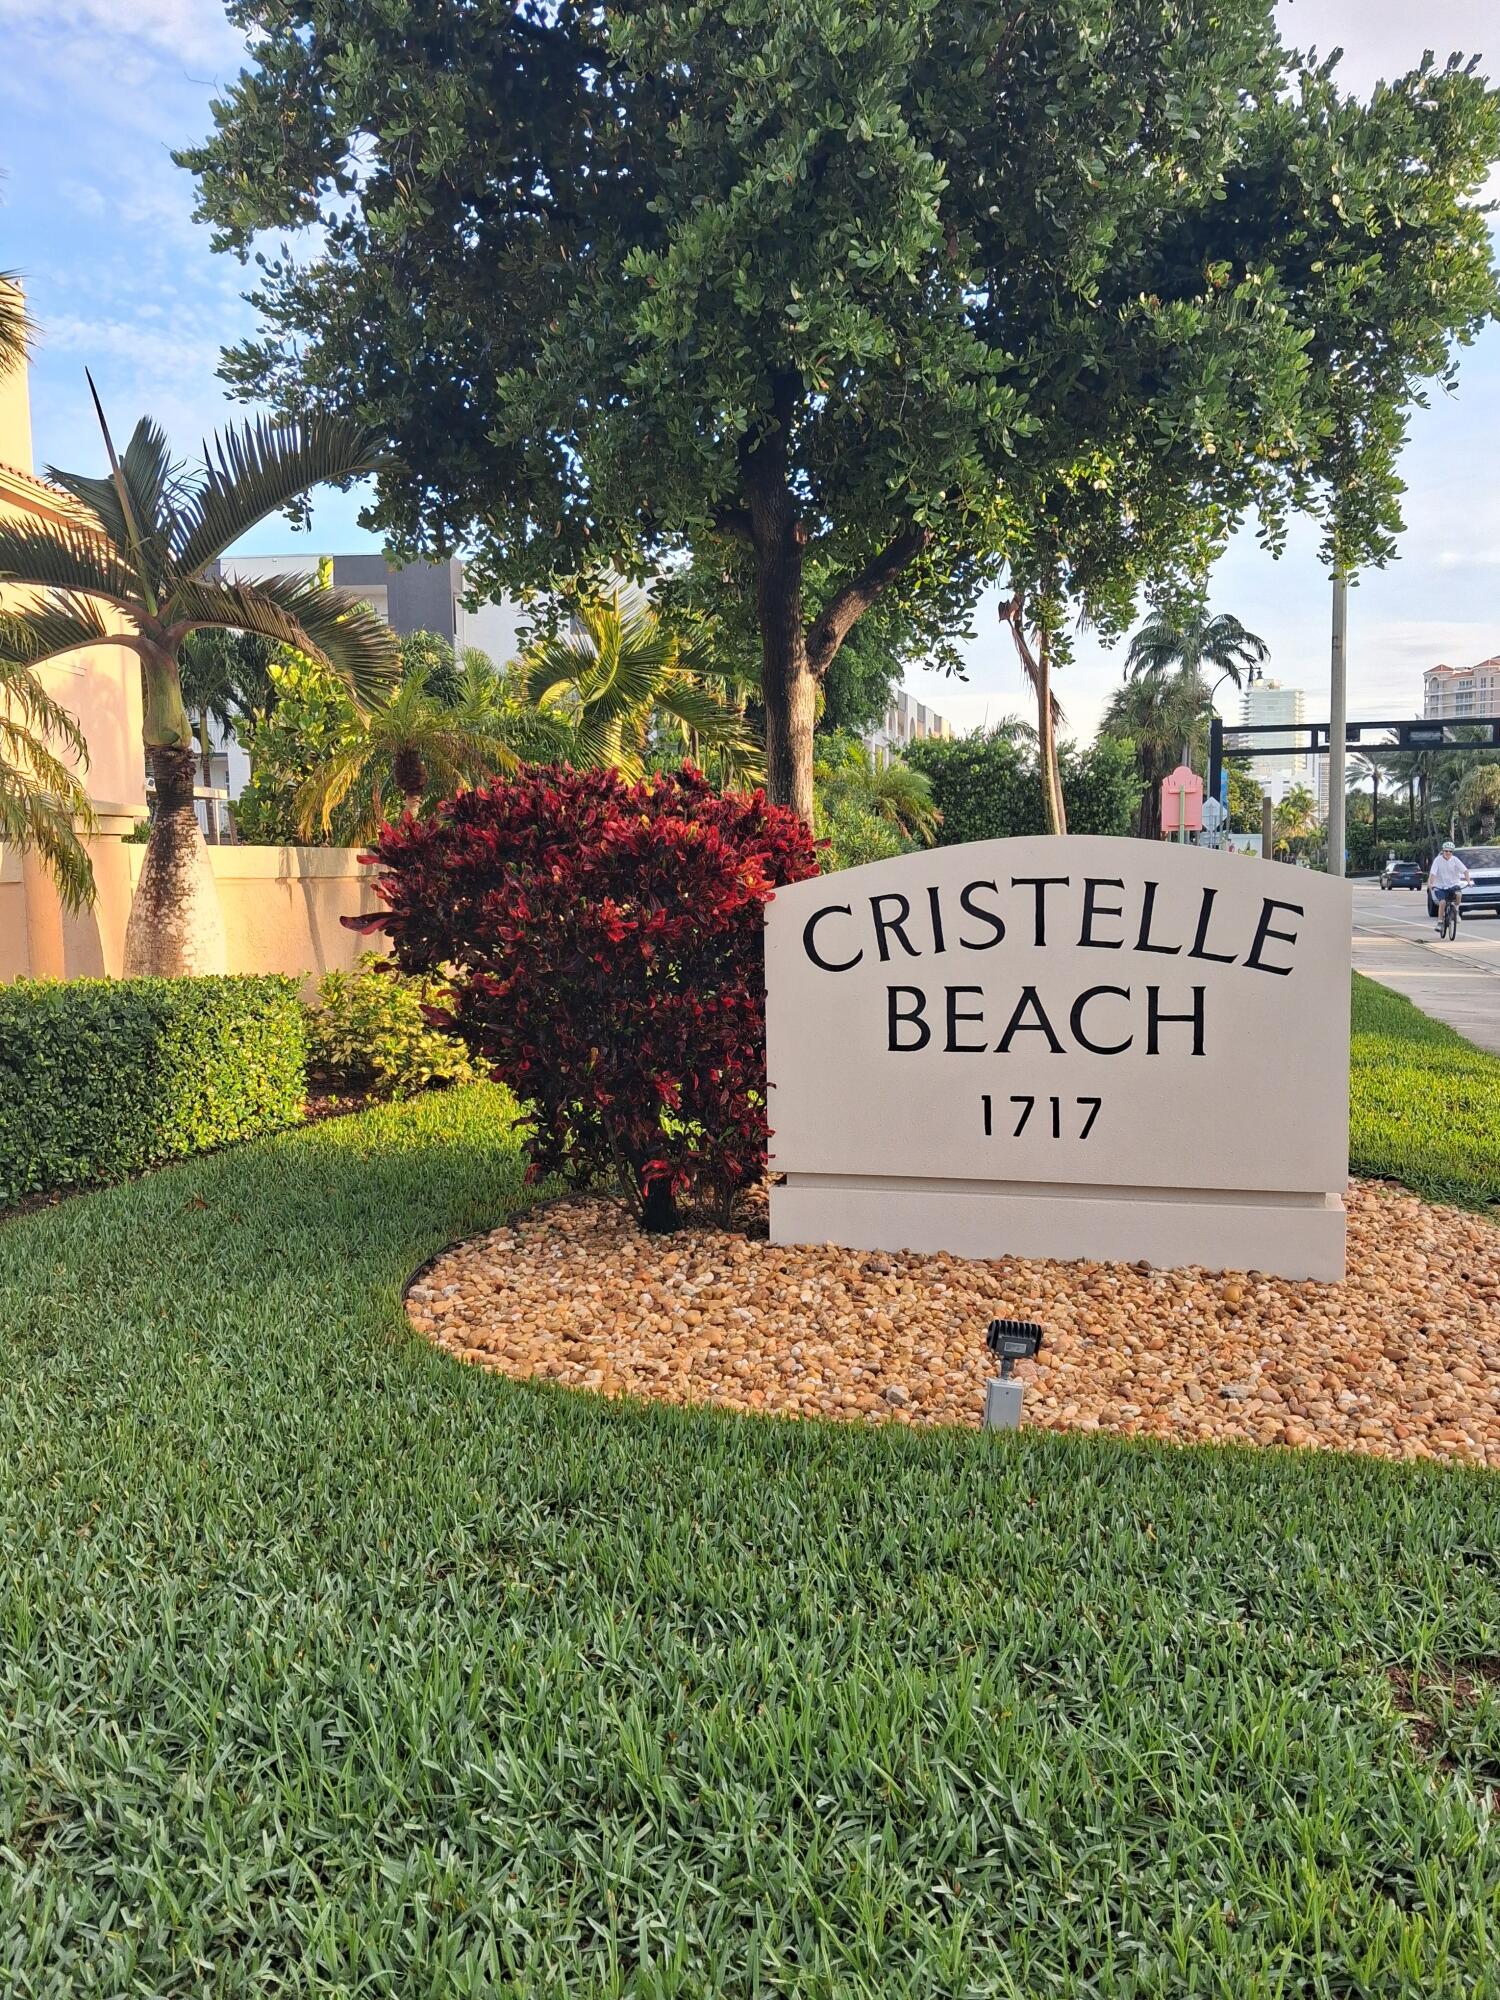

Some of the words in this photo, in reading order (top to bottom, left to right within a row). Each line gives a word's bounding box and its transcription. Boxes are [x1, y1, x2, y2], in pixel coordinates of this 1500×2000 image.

[802, 877, 1305, 976] CRISTELLE
[887, 985, 1207, 1056] BEACH
[981, 1095, 1102, 1139] 1717
